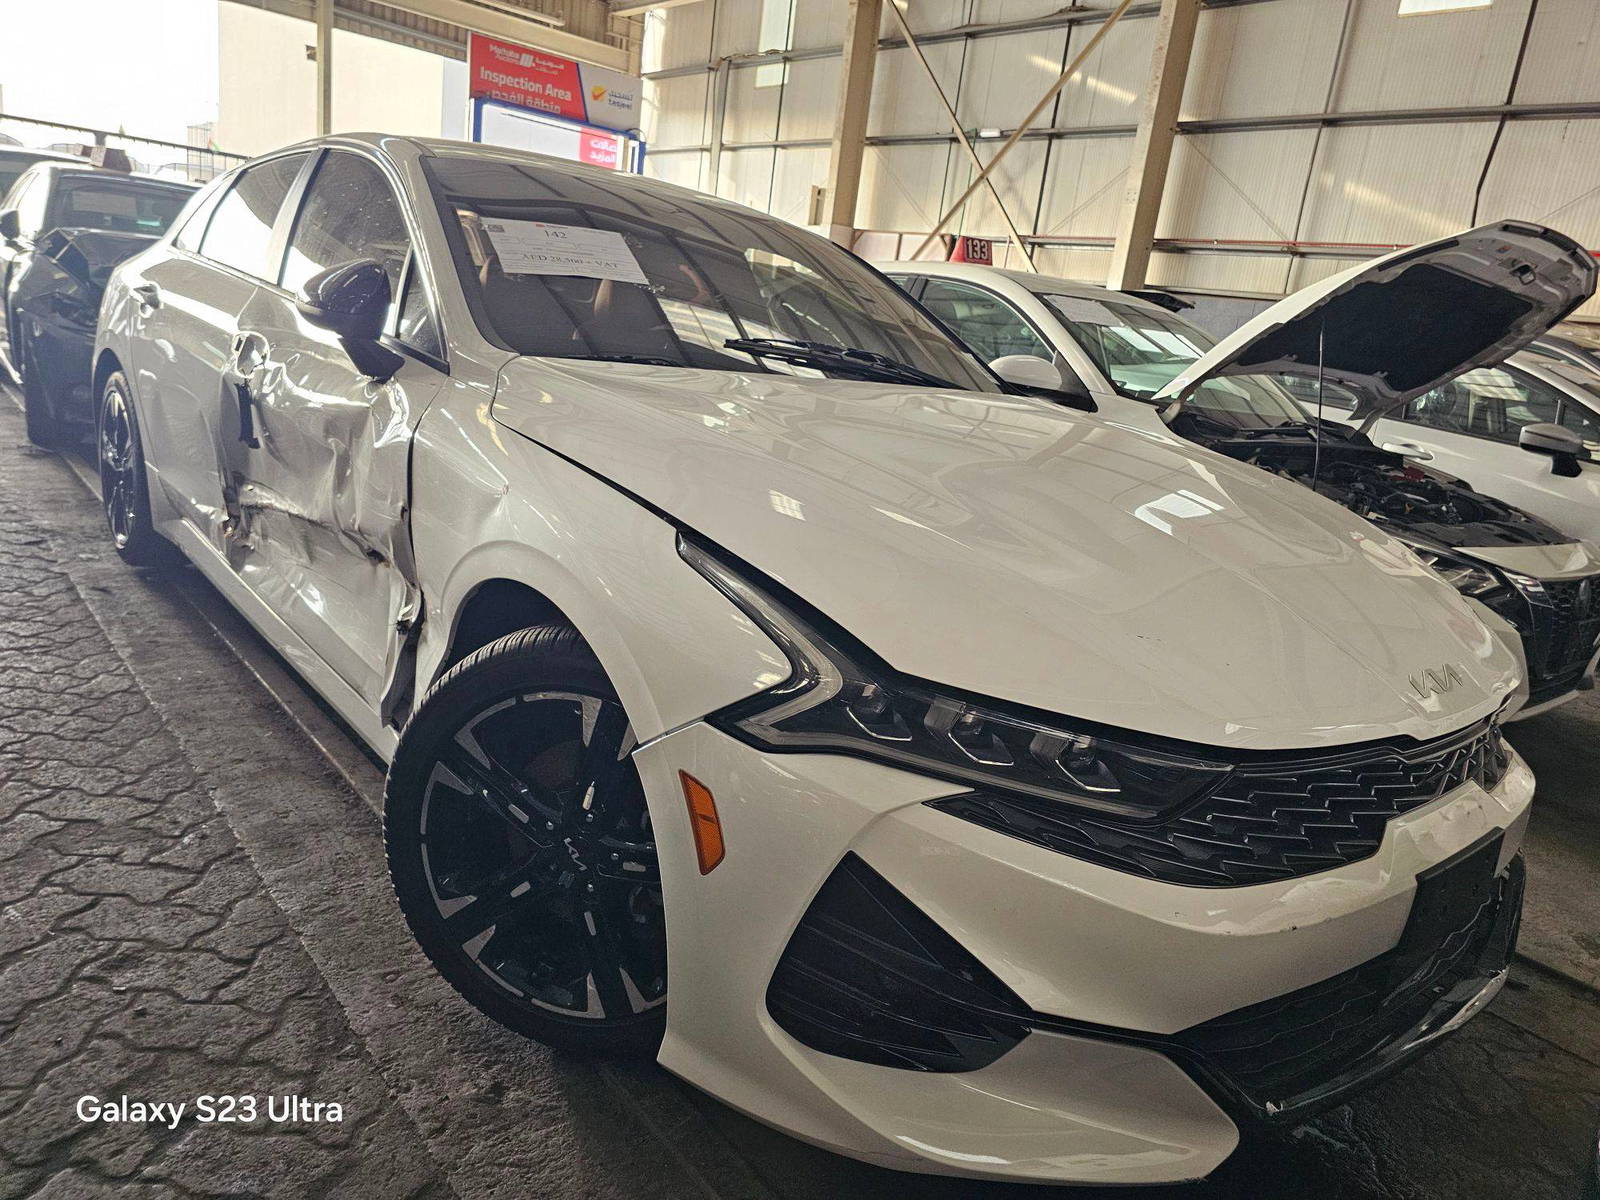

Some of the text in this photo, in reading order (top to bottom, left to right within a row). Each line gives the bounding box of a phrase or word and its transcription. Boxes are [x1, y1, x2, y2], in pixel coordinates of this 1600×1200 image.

[480, 66, 572, 101] Inspection Area
[544, 230, 568, 239] 142
[967, 240, 988, 260] 133
[1408, 664, 1463, 699] KIA
